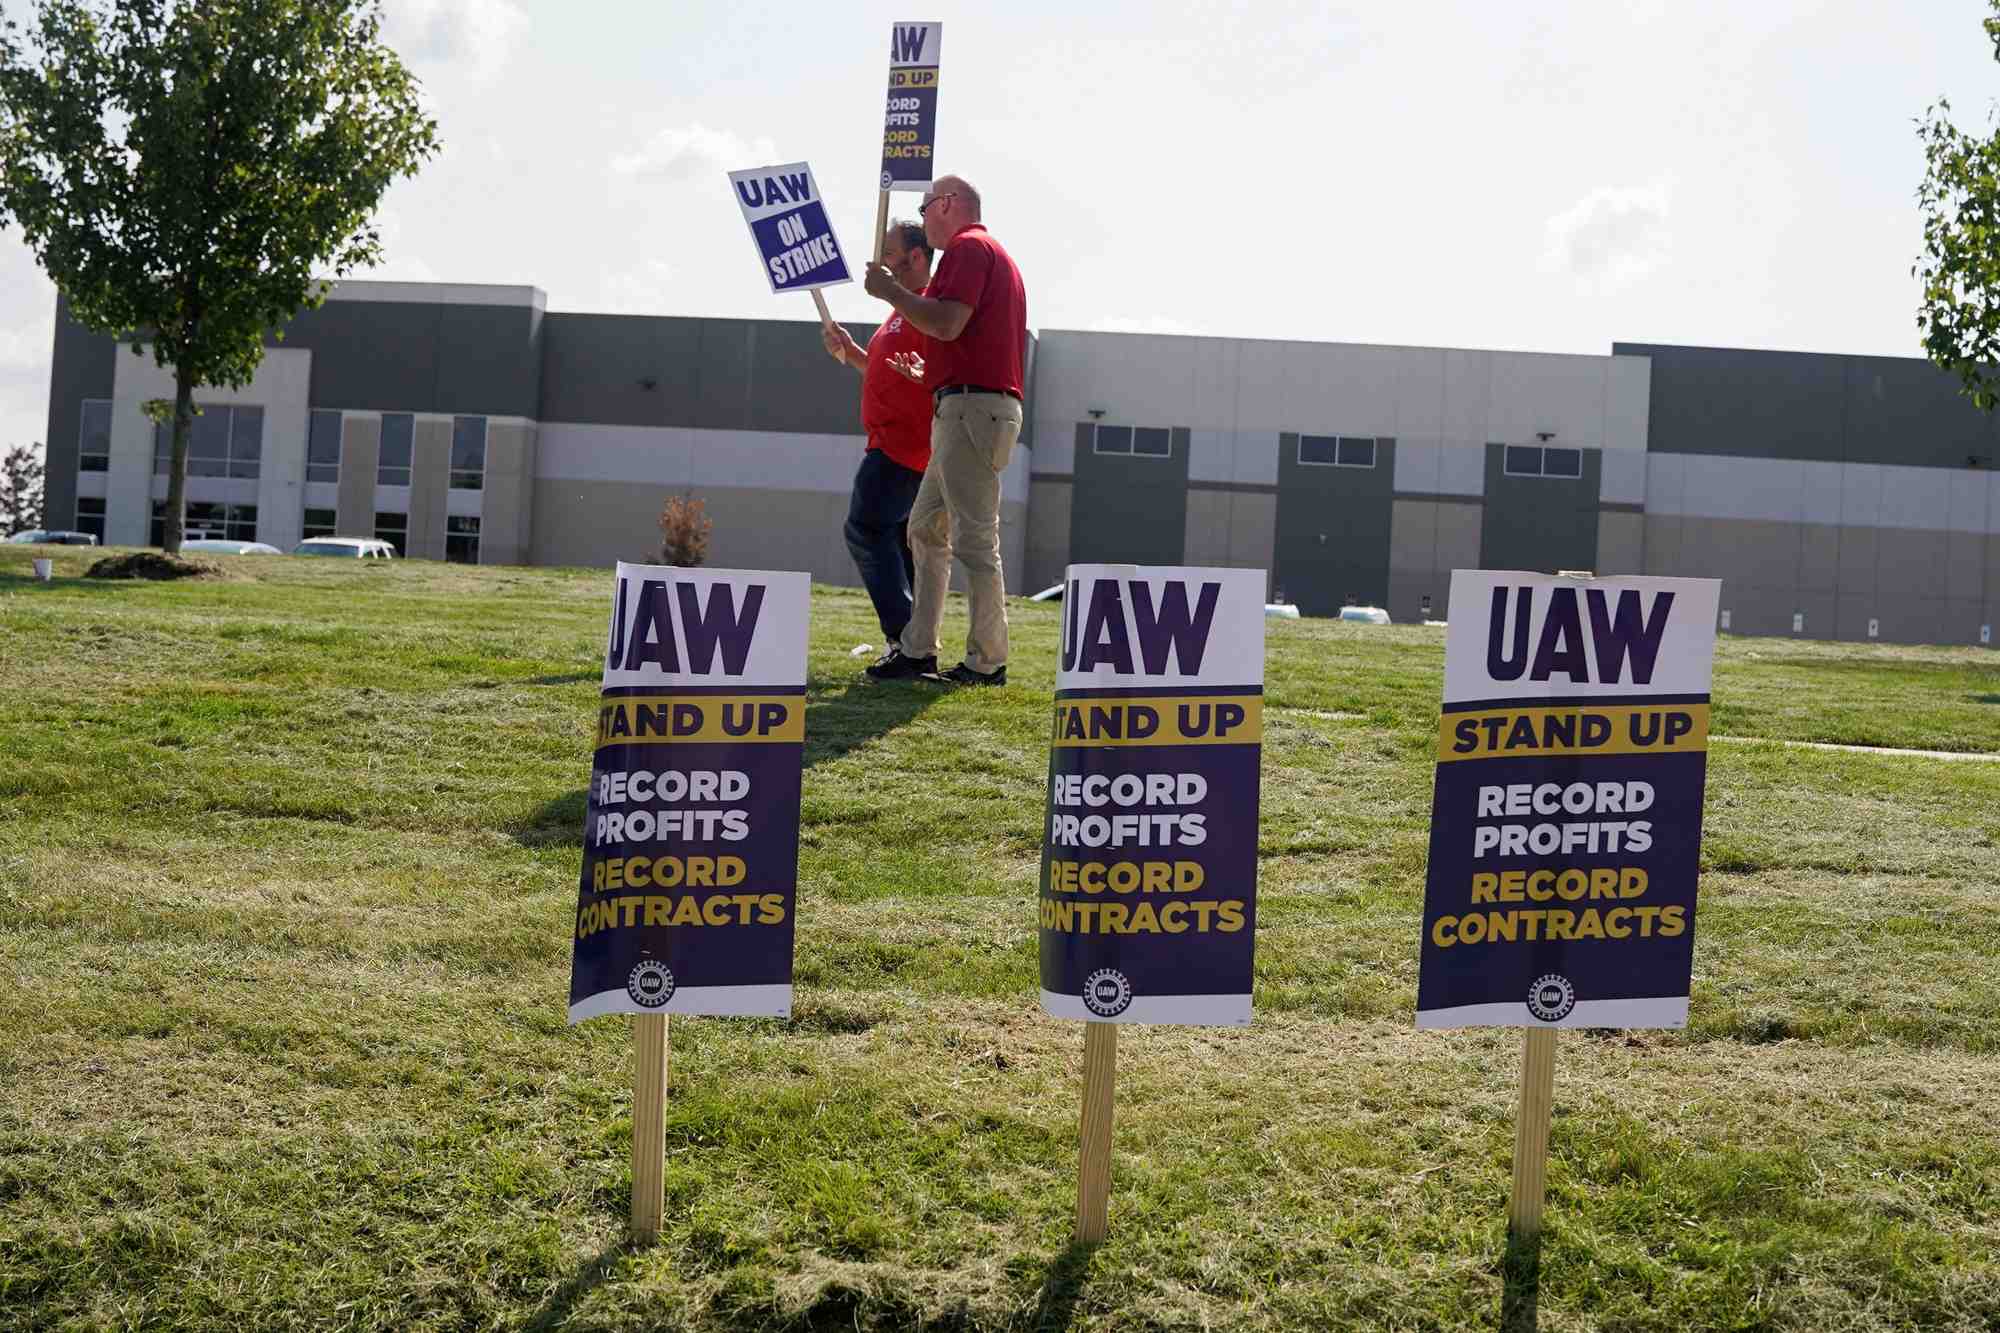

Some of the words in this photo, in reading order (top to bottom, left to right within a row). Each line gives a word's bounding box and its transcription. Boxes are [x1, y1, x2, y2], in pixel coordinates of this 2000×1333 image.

[884, 144, 930, 158] RACTS
[736, 173, 811, 208] UAW
[777, 213, 808, 247] ON
[769, 234, 837, 284] STRIKE
[610, 577, 766, 676] UAW
[1061, 579, 1222, 676] UAW
[1487, 586, 1675, 685] UAW
[598, 703, 704, 739] TAND
[721, 703, 788, 736] UP
[1056, 704, 1160, 740] TAND
[1177, 703, 1245, 737] UP
[1453, 714, 1612, 754] STAND
[1629, 712, 1693, 746] UP
[599, 770, 750, 806] RECORD
[1054, 773, 1208, 807] RECORD
[1477, 780, 1655, 818] RECORD
[596, 809, 749, 847] PROFITS
[1051, 813, 1208, 848] PROFITS
[1473, 820, 1653, 858] PROFITS
[592, 855, 747, 893] RECORD
[1050, 861, 1205, 894] RECORD
[1471, 867, 1649, 904] RECORD
[578, 893, 785, 939] CONTRACTS
[1431, 905, 1686, 948] CONTRACTS
